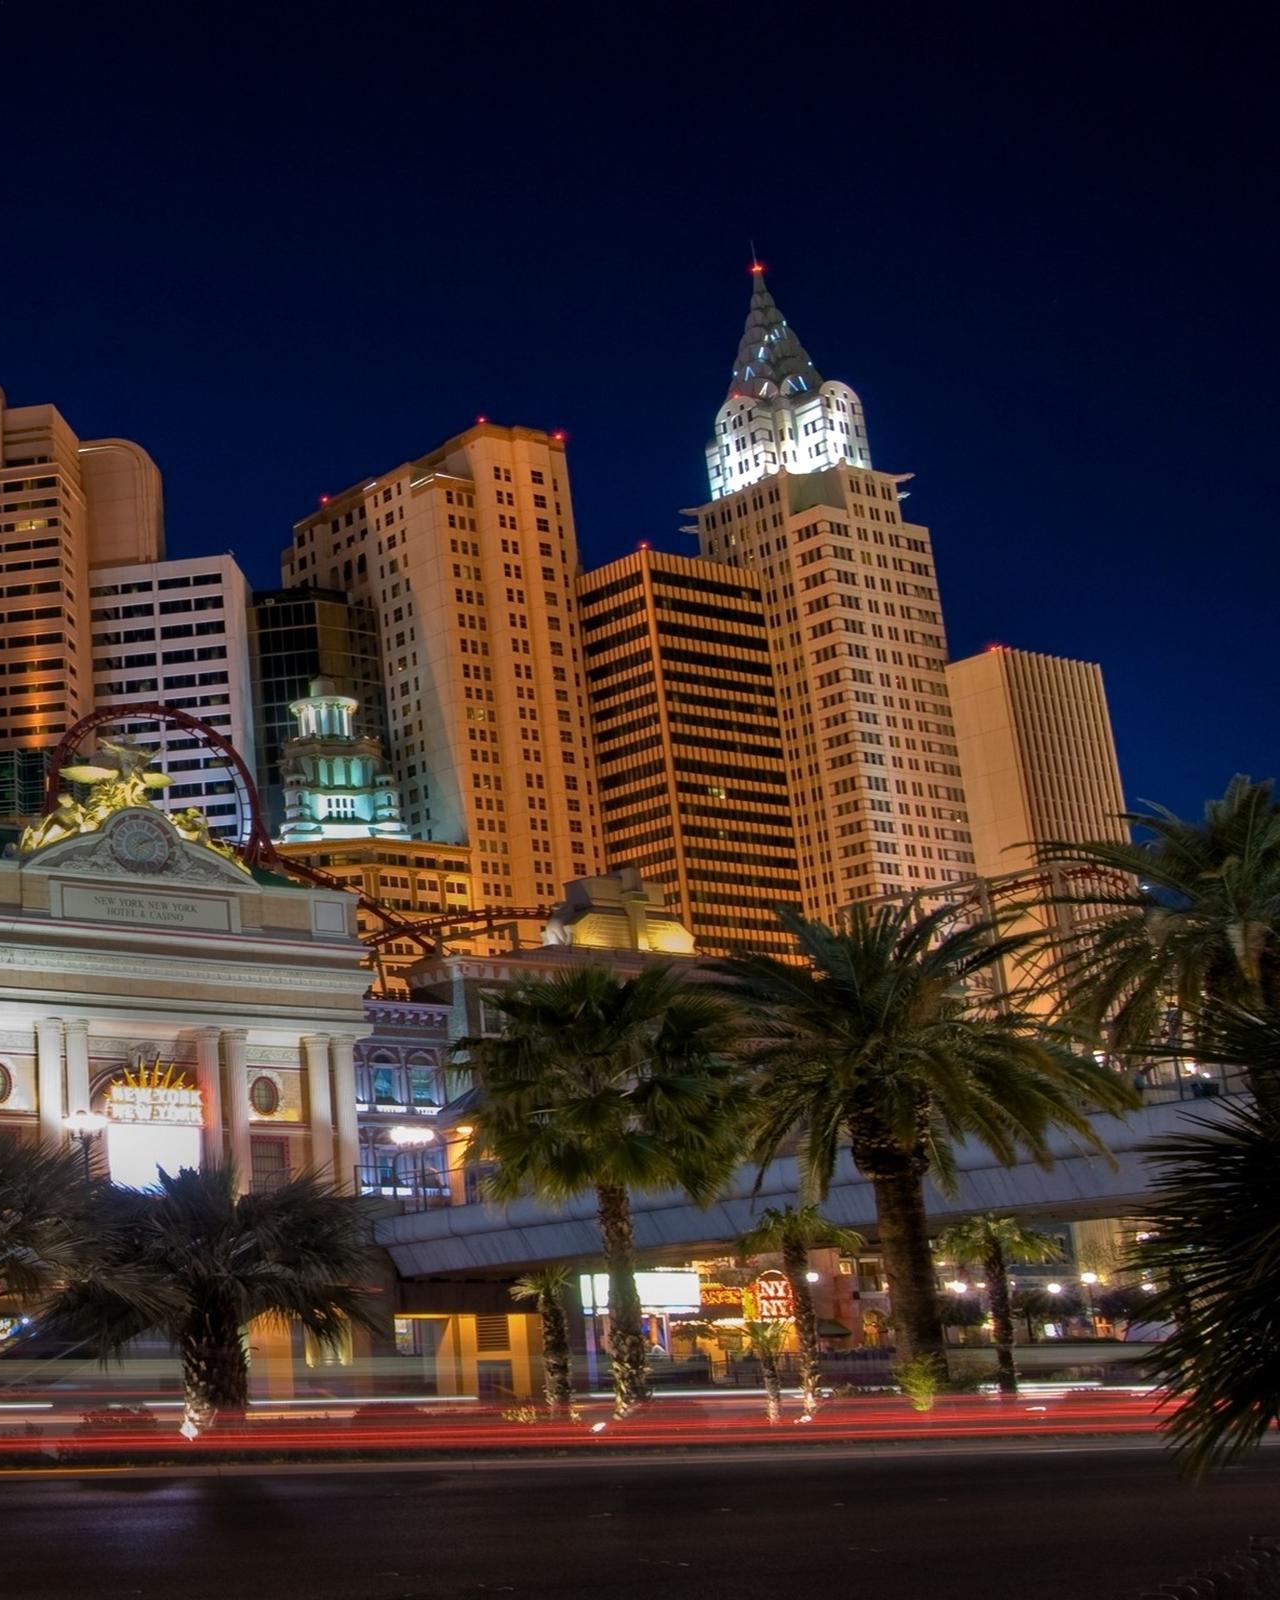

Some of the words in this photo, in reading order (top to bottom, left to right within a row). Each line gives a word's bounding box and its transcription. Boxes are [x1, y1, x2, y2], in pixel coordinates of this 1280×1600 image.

[94, 896, 115, 905] NEW
[120, 899, 144, 909] YORK
[148, 902, 170, 911] NEW
[172, 903, 198, 913] YORK
[107, 907, 137, 918] HOTEL
[149, 911, 184, 922] CASINO
[760, 1281, 786, 1297] NY
[760, 1299, 788, 1316] NY
